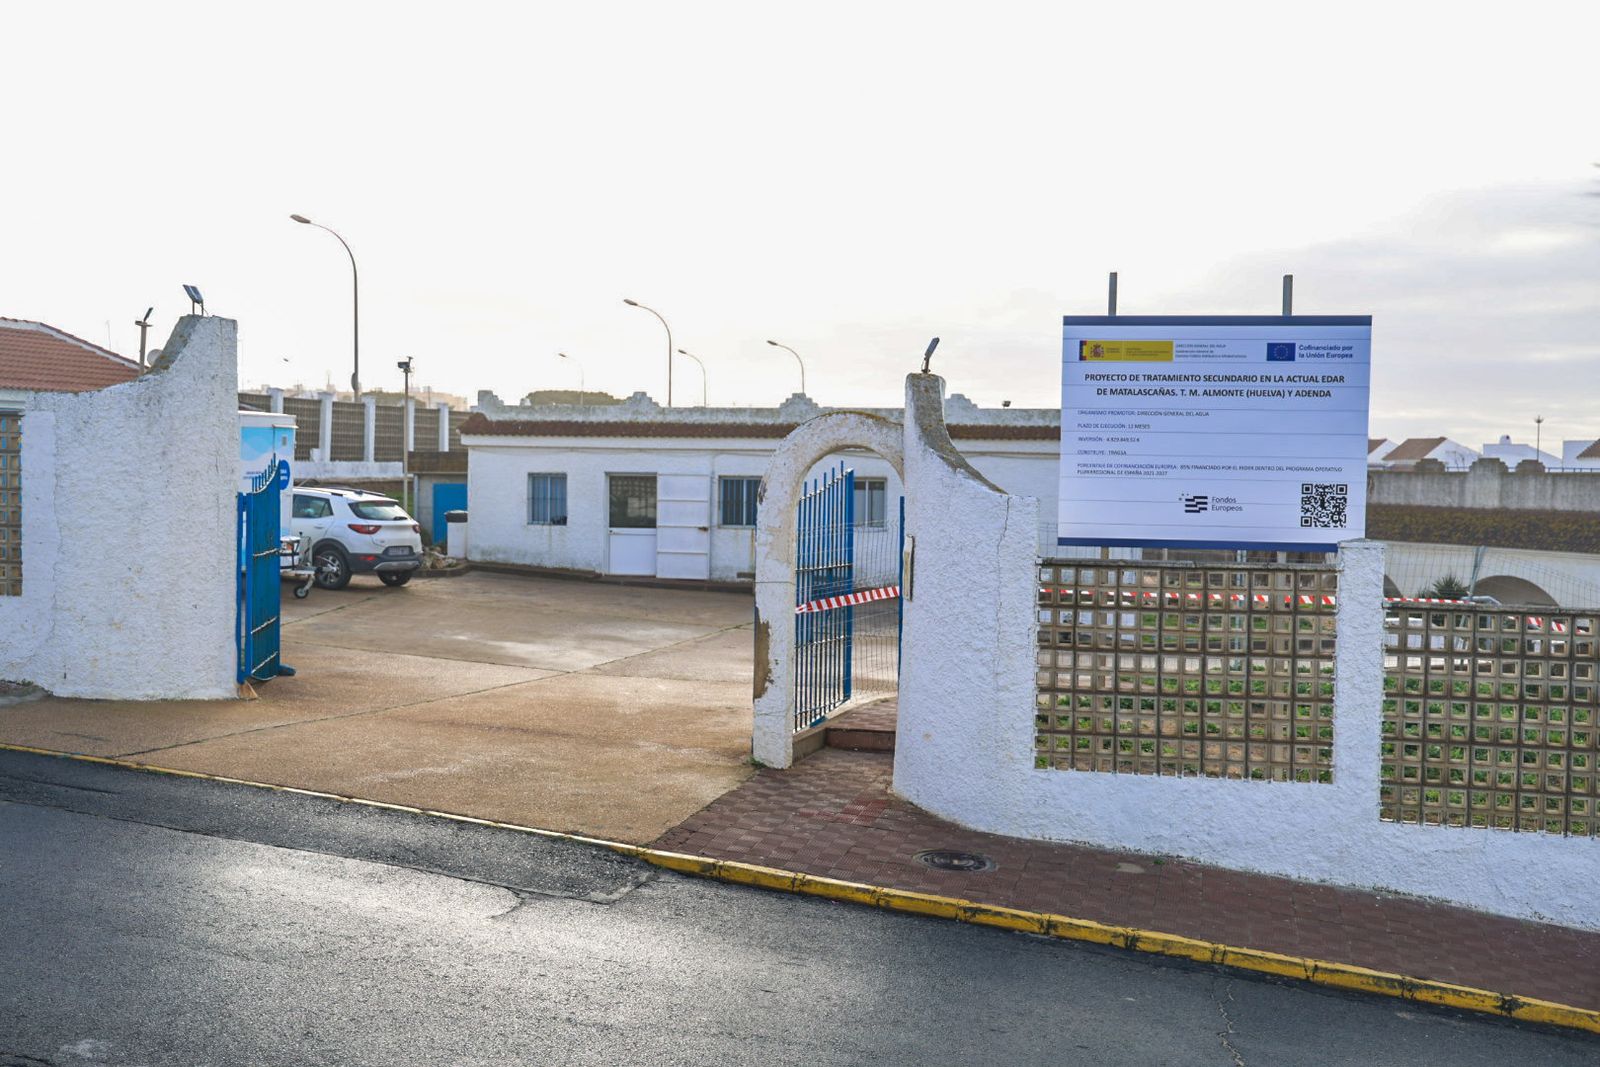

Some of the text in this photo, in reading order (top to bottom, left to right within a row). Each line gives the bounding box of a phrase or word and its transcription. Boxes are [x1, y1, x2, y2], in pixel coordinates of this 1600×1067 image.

[1142, 374, 1201, 382] TRATAMIENTO
[1203, 374, 1258, 382] SECUNDARIO
[1260, 375, 1271, 383] EN
[1274, 375, 1284, 383] LA
[1286, 375, 1319, 383] ACTUAL
[1096, 388, 1108, 396] DE
[1189, 389, 1200, 397] M.
[1202, 389, 1244, 397] ALMONTE
[1246, 389, 1285, 399] (HUELVA)
[1211, 496, 1237, 504] Fondos
[1211, 504, 1243, 512] Europeos
